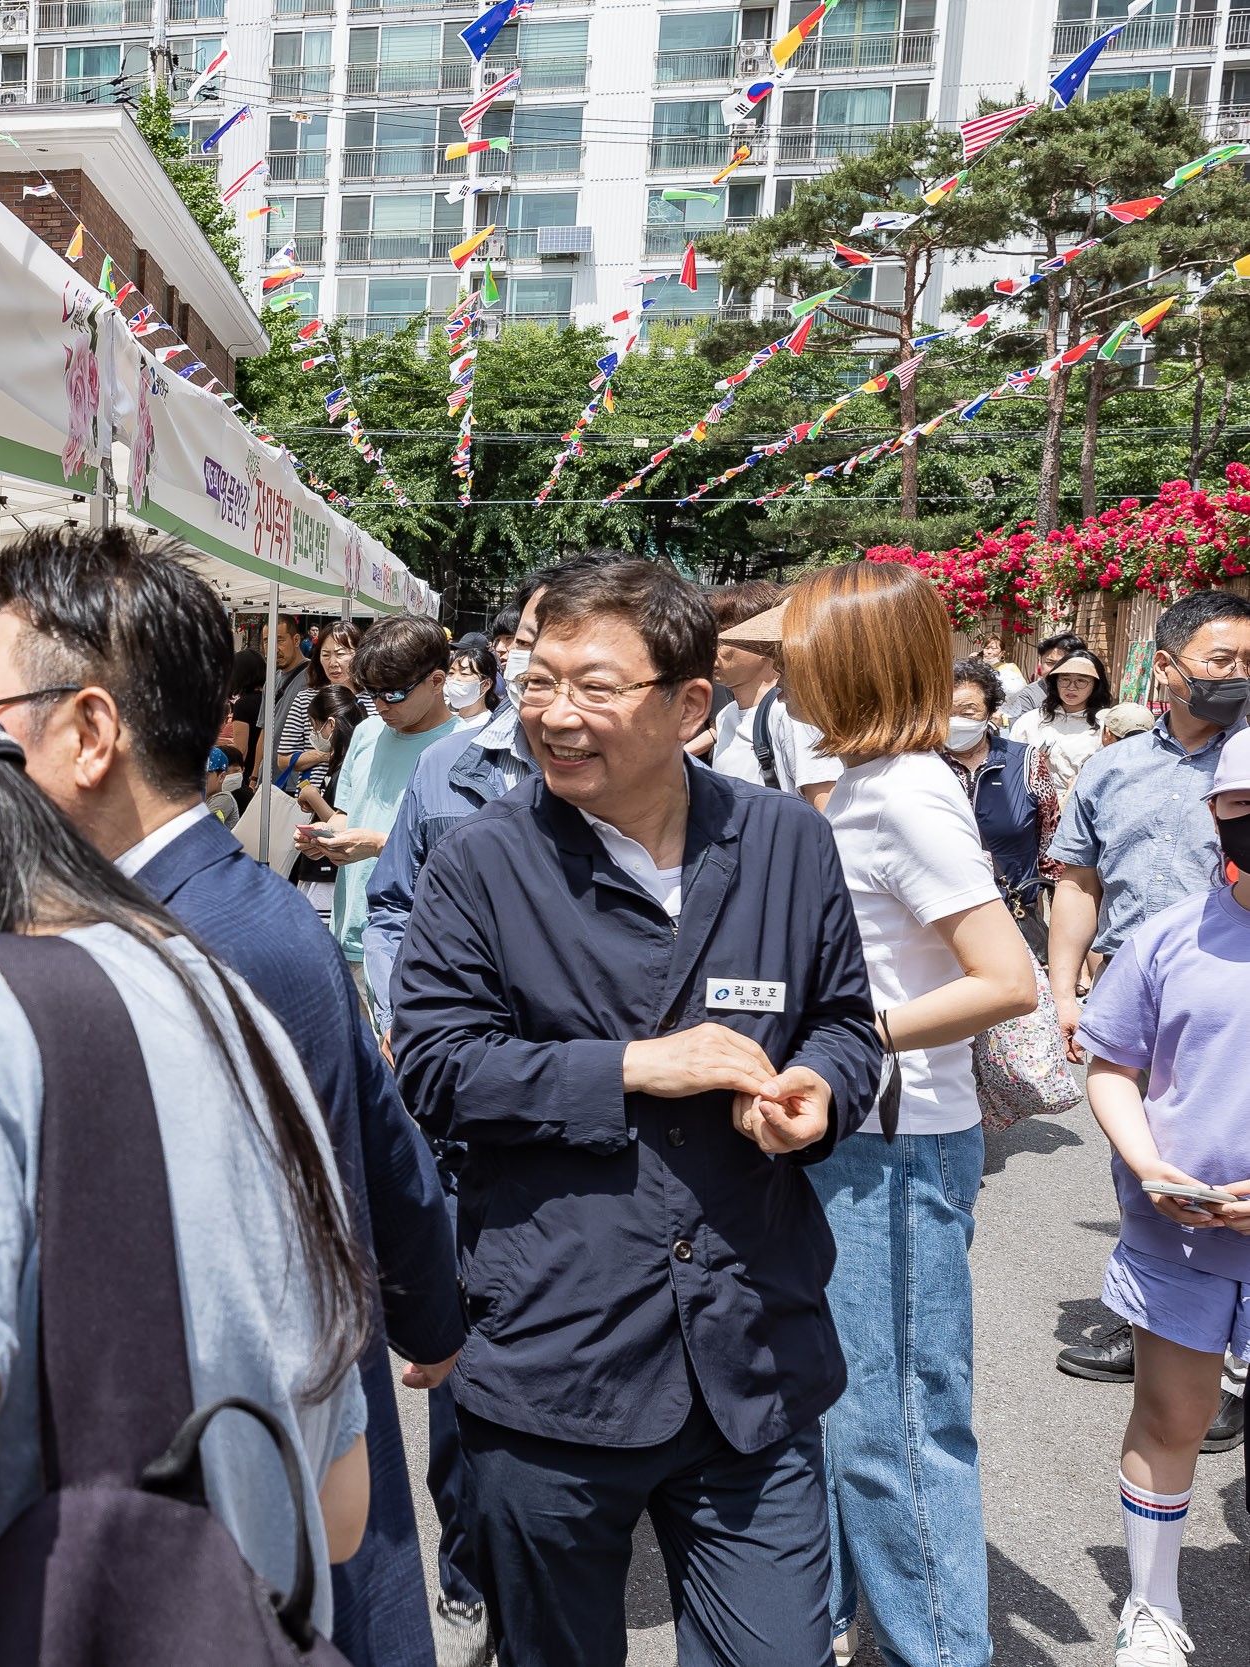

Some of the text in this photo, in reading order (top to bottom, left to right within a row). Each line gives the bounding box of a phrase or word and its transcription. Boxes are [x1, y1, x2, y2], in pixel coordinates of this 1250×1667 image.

[220, 469, 251, 532] 명품한강
[254, 477, 292, 566] 장미축제
[292, 506, 315, 565] 열쇠고리
[315, 521, 331, 575] 만들기
[739, 998, 771, 1007] 광진구청장
